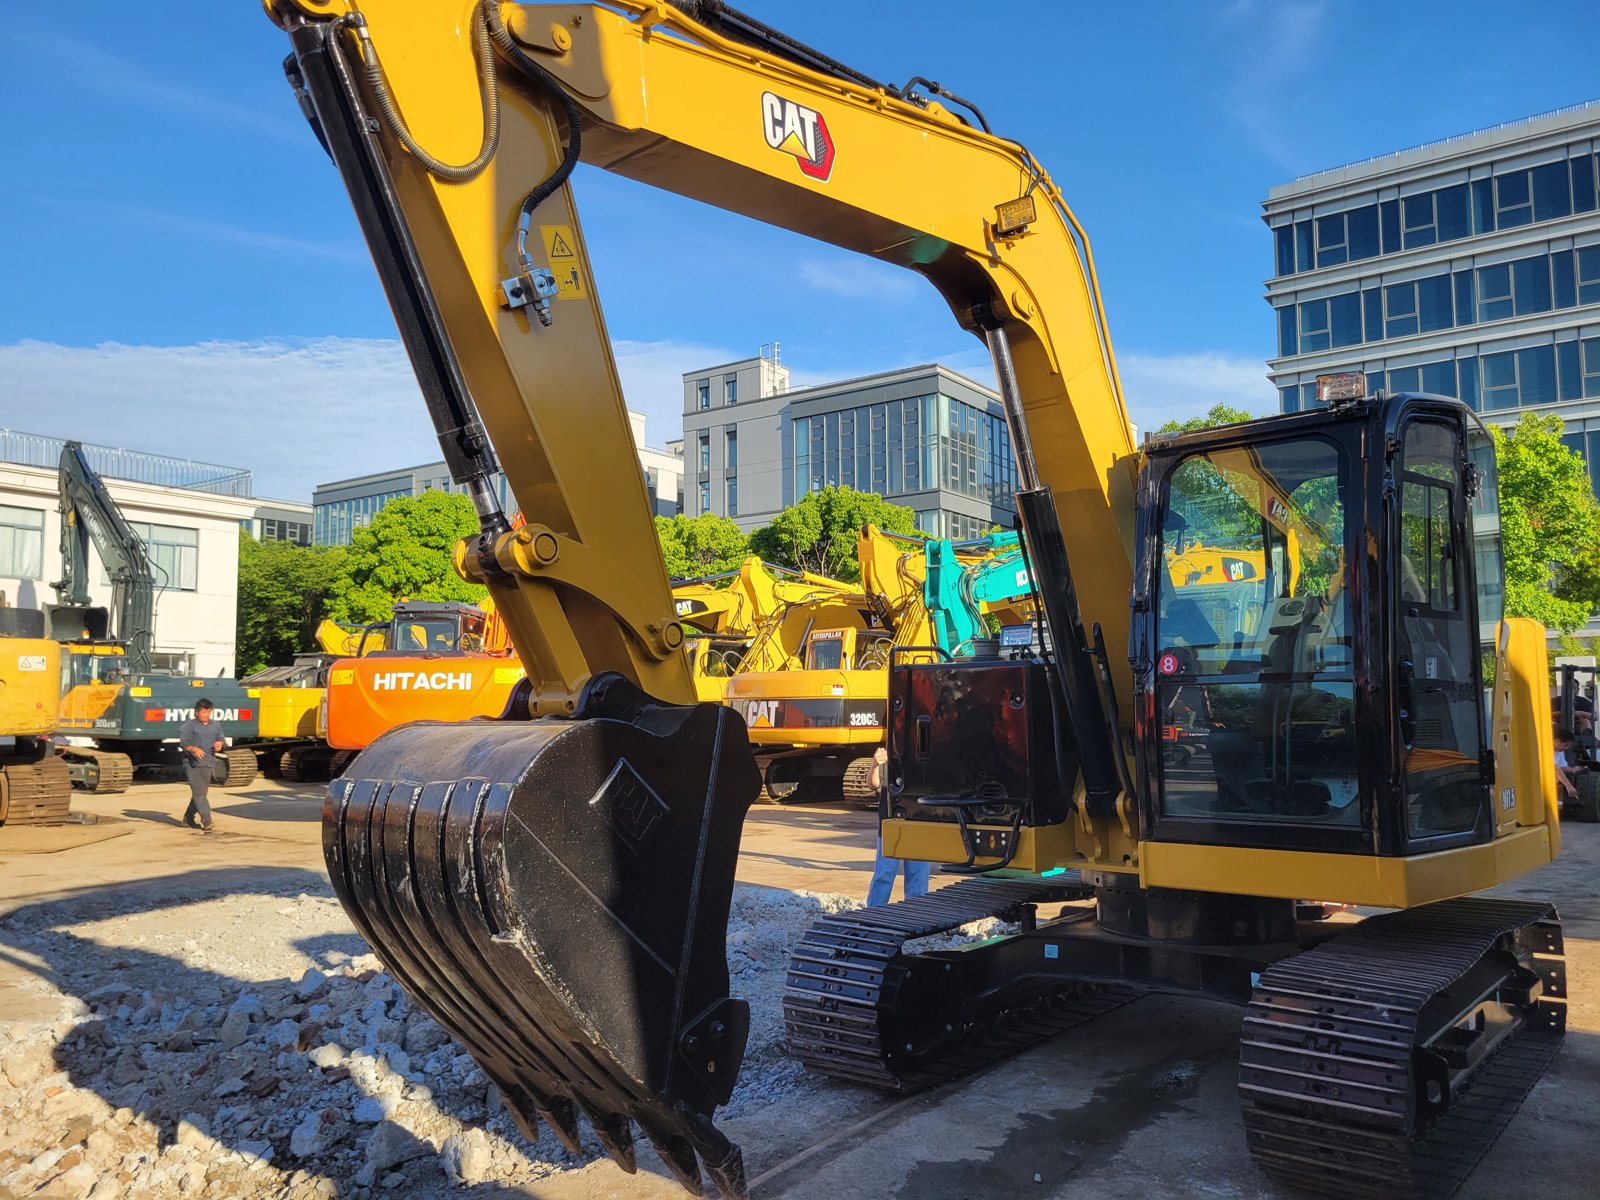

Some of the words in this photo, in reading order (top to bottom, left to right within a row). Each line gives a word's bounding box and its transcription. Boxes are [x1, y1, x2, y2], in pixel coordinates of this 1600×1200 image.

[763, 92, 818, 162] CAT
[83, 504, 106, 550] HYUNDAI
[1231, 562, 1244, 581] CAT
[676, 600, 692, 616] CAT
[812, 631, 842, 640] CATERPILLAR
[1163, 657, 1174, 672] 8
[374, 672, 472, 690] HITACHI
[165, 708, 239, 722] HYUDAI
[748, 701, 779, 727] CAT
[850, 713, 879, 726] 320CL
